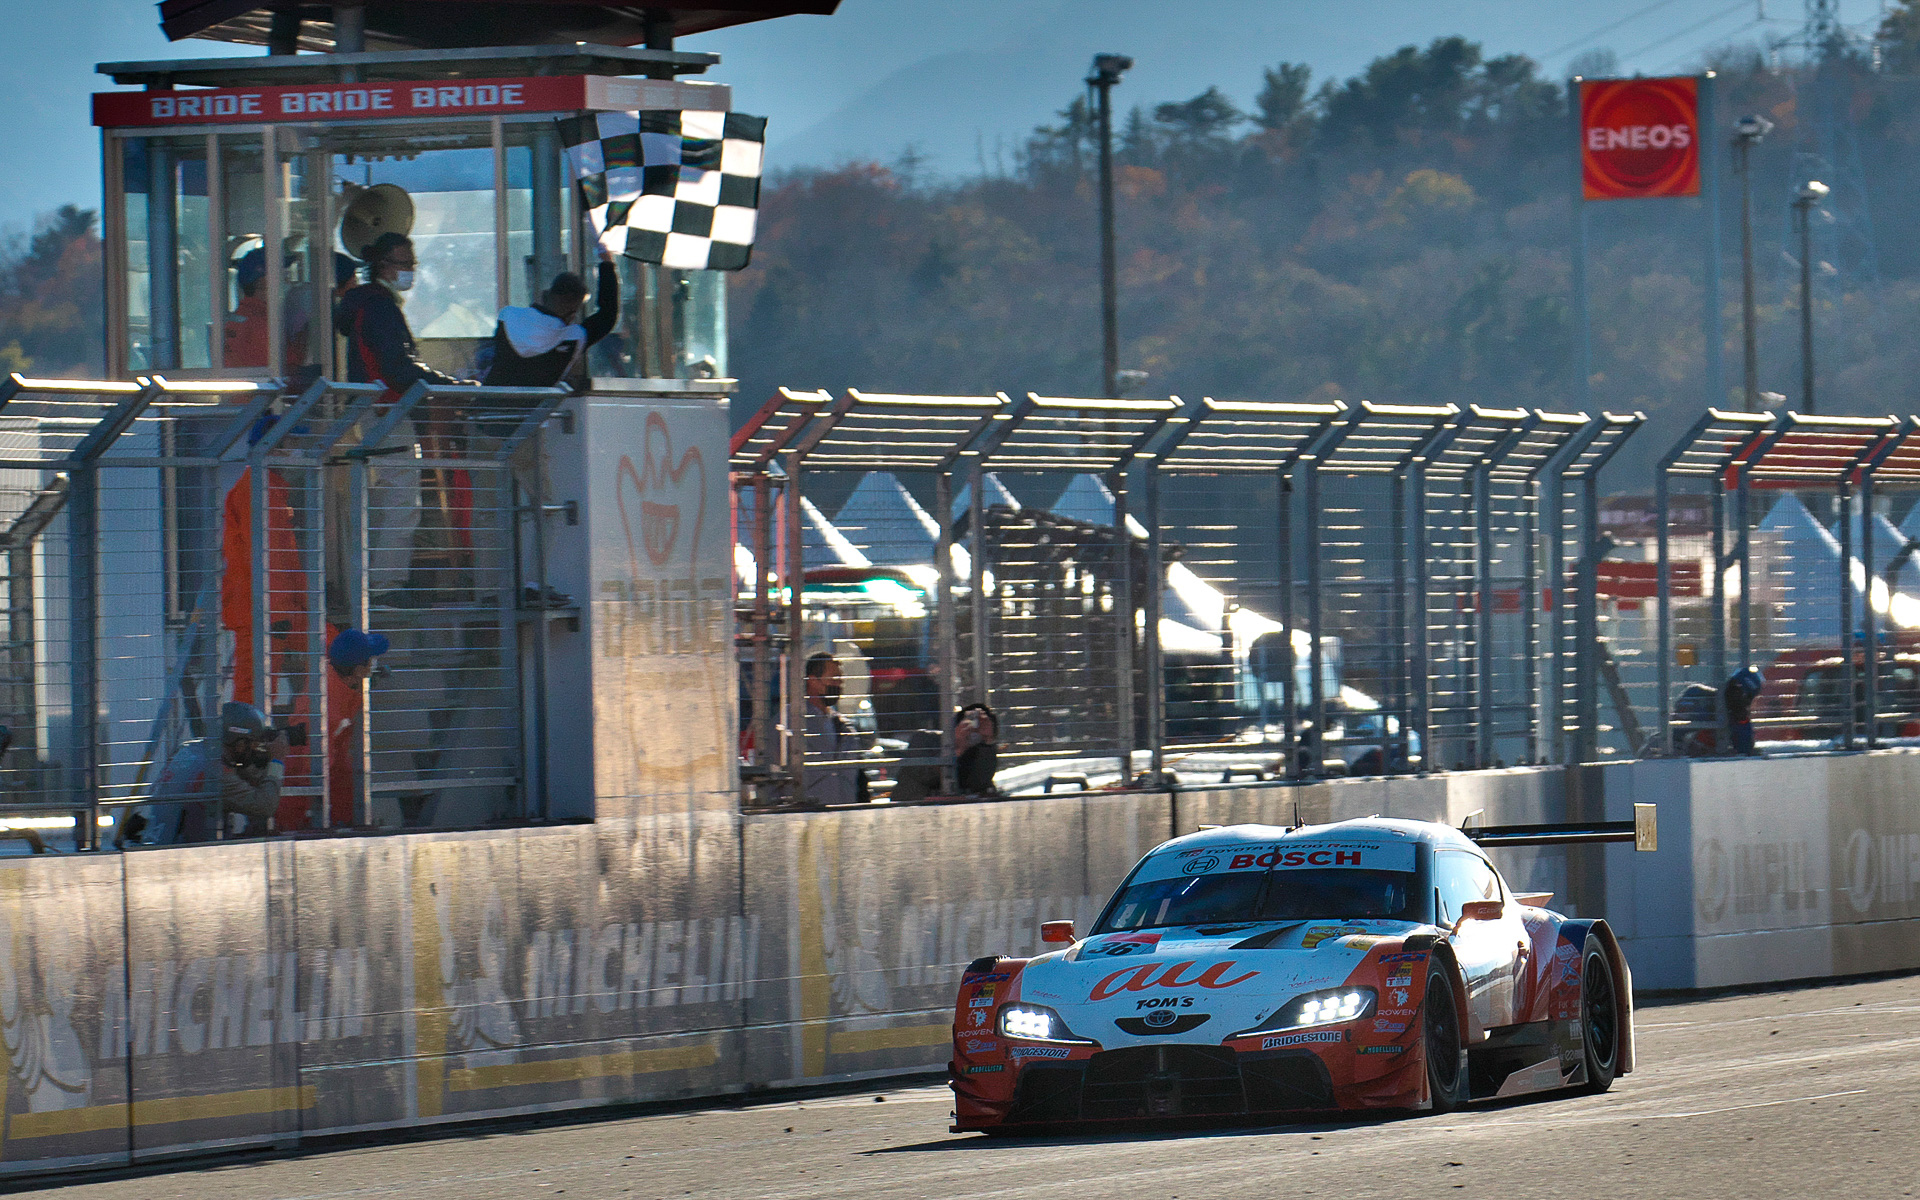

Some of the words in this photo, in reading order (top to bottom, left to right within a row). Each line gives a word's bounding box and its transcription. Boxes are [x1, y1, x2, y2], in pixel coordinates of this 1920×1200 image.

[150, 93, 263, 118] BRIDE
[279, 88, 394, 113] BRIDE
[410, 84, 525, 108] BRIDE
[1588, 124, 1691, 150] ENEOS
[1228, 851, 1361, 869] BOSCH
[1088, 941, 1136, 956] 36
[524, 914, 762, 1020] MICHELIN
[1089, 960, 1261, 1001] au
[99, 947, 370, 1059] MICHELIN
[1136, 996, 1195, 1010] TOM'S
[957, 1028, 995, 1038] ROWEN
[1262, 1031, 1341, 1049] BRIDGESTONE
